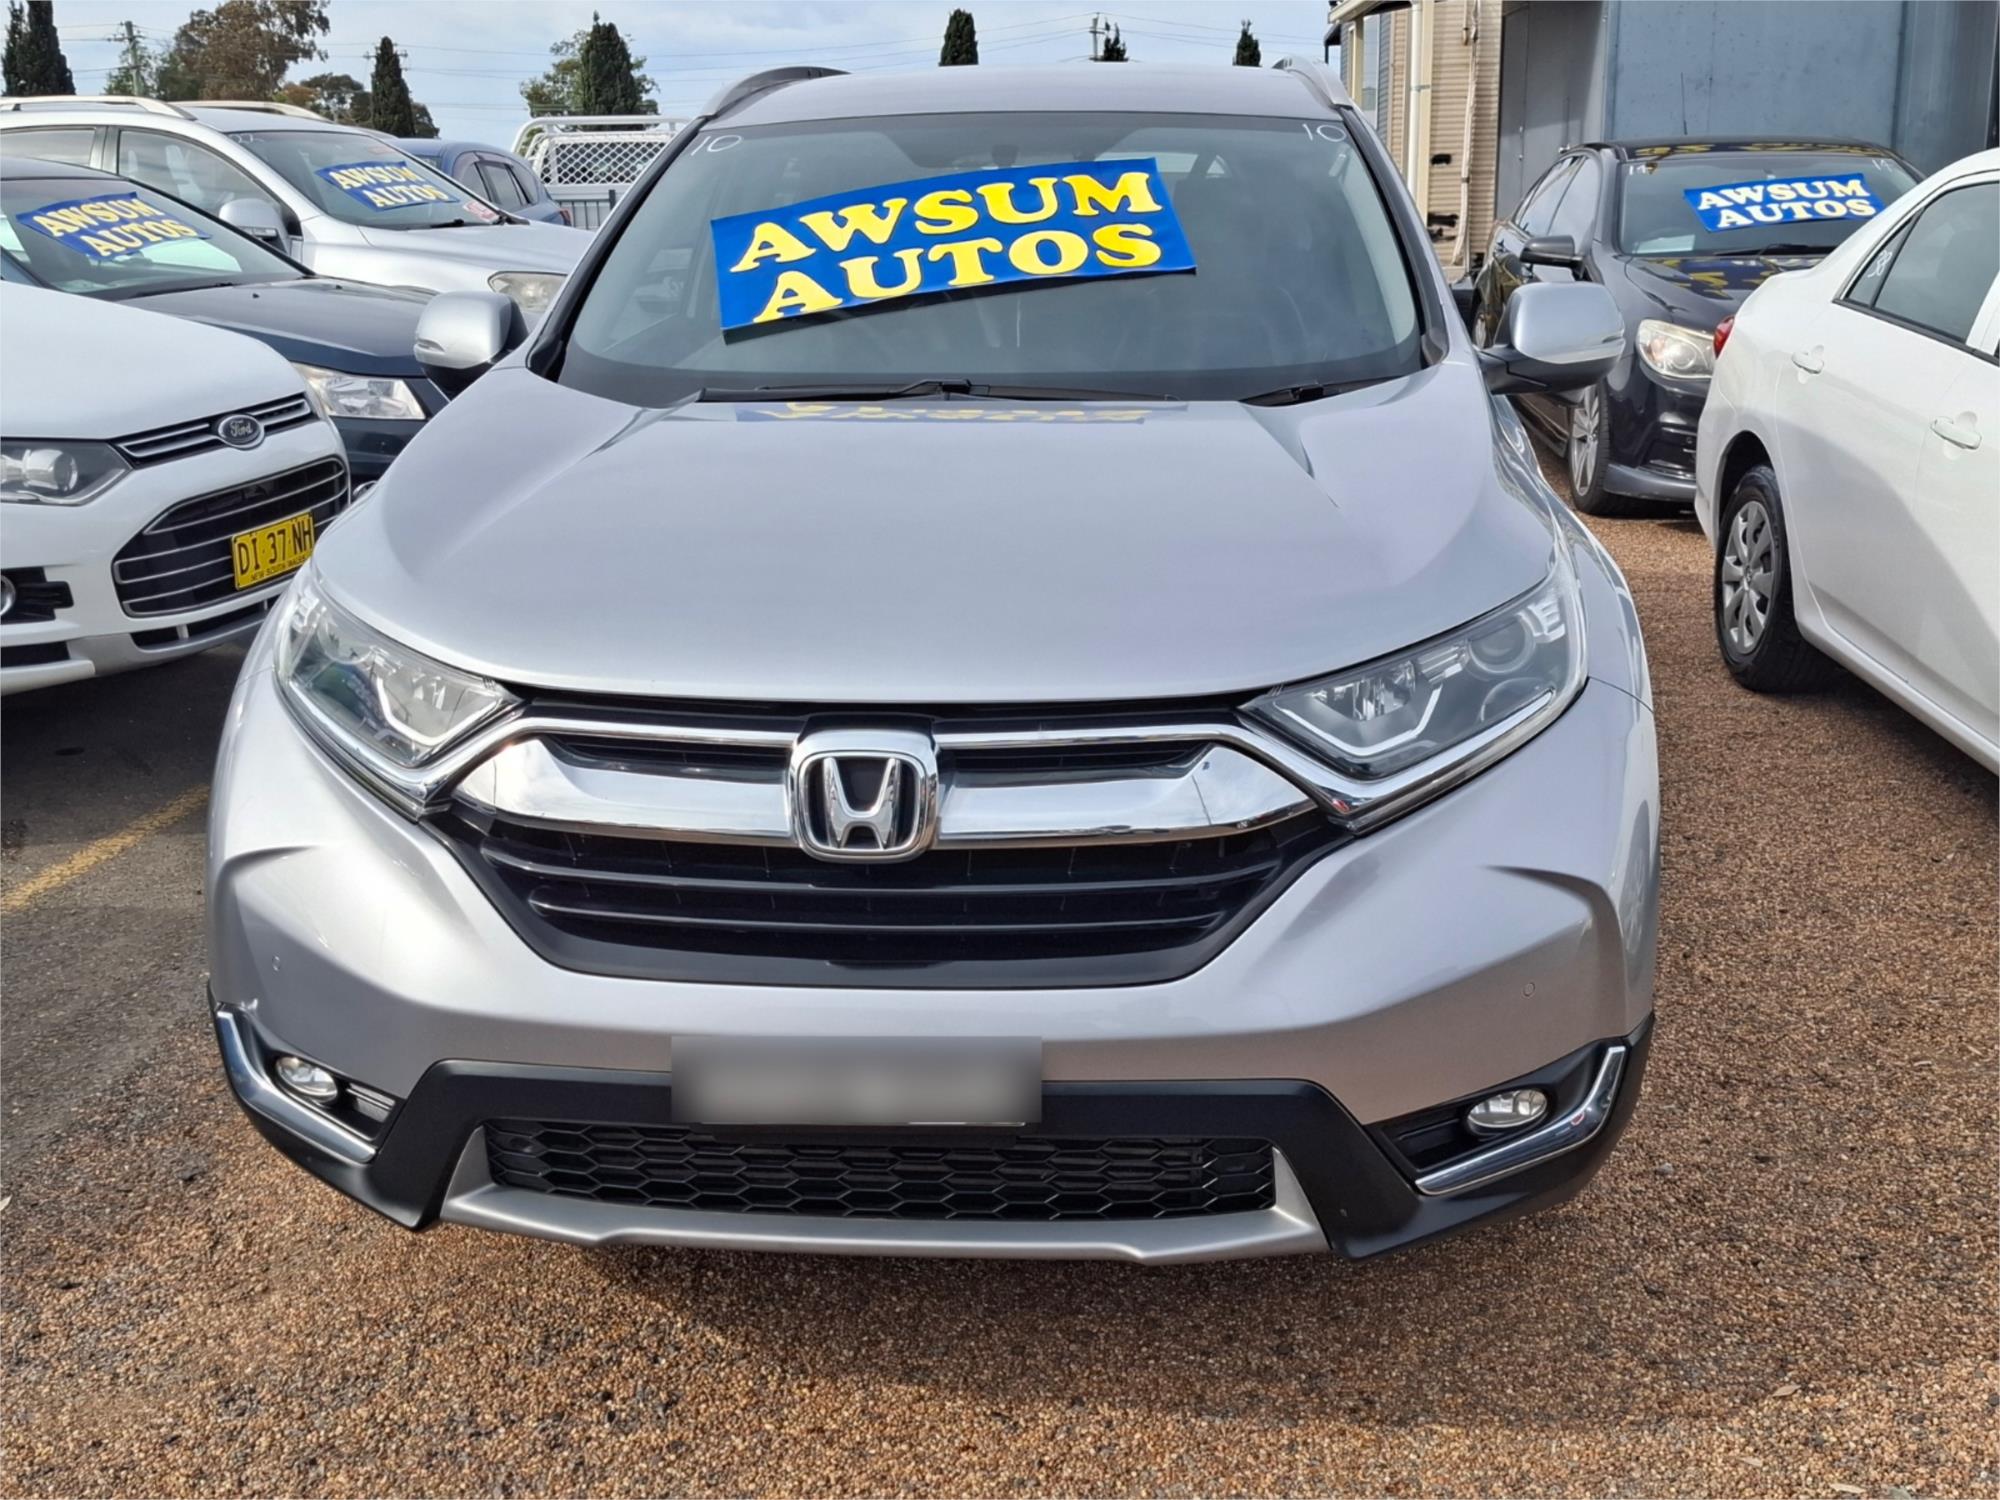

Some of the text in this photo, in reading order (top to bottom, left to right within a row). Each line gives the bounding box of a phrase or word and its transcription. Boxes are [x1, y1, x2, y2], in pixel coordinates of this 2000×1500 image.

[690, 134, 743, 156] 10
[1302, 123, 1347, 142] 10
[329, 165, 426, 190] AWSUM
[363, 184, 449, 208] AUTOS
[1698, 179, 1872, 211] AWSUM
[33, 198, 166, 237] AWSUM
[730, 172, 1163, 273] AWSUM
[1716, 200, 1877, 228] AUTOS
[80, 218, 198, 257] AUTOS
[753, 223, 1162, 323] AUTOS
[267, 528, 286, 565] 37
[292, 518, 312, 555] NH
